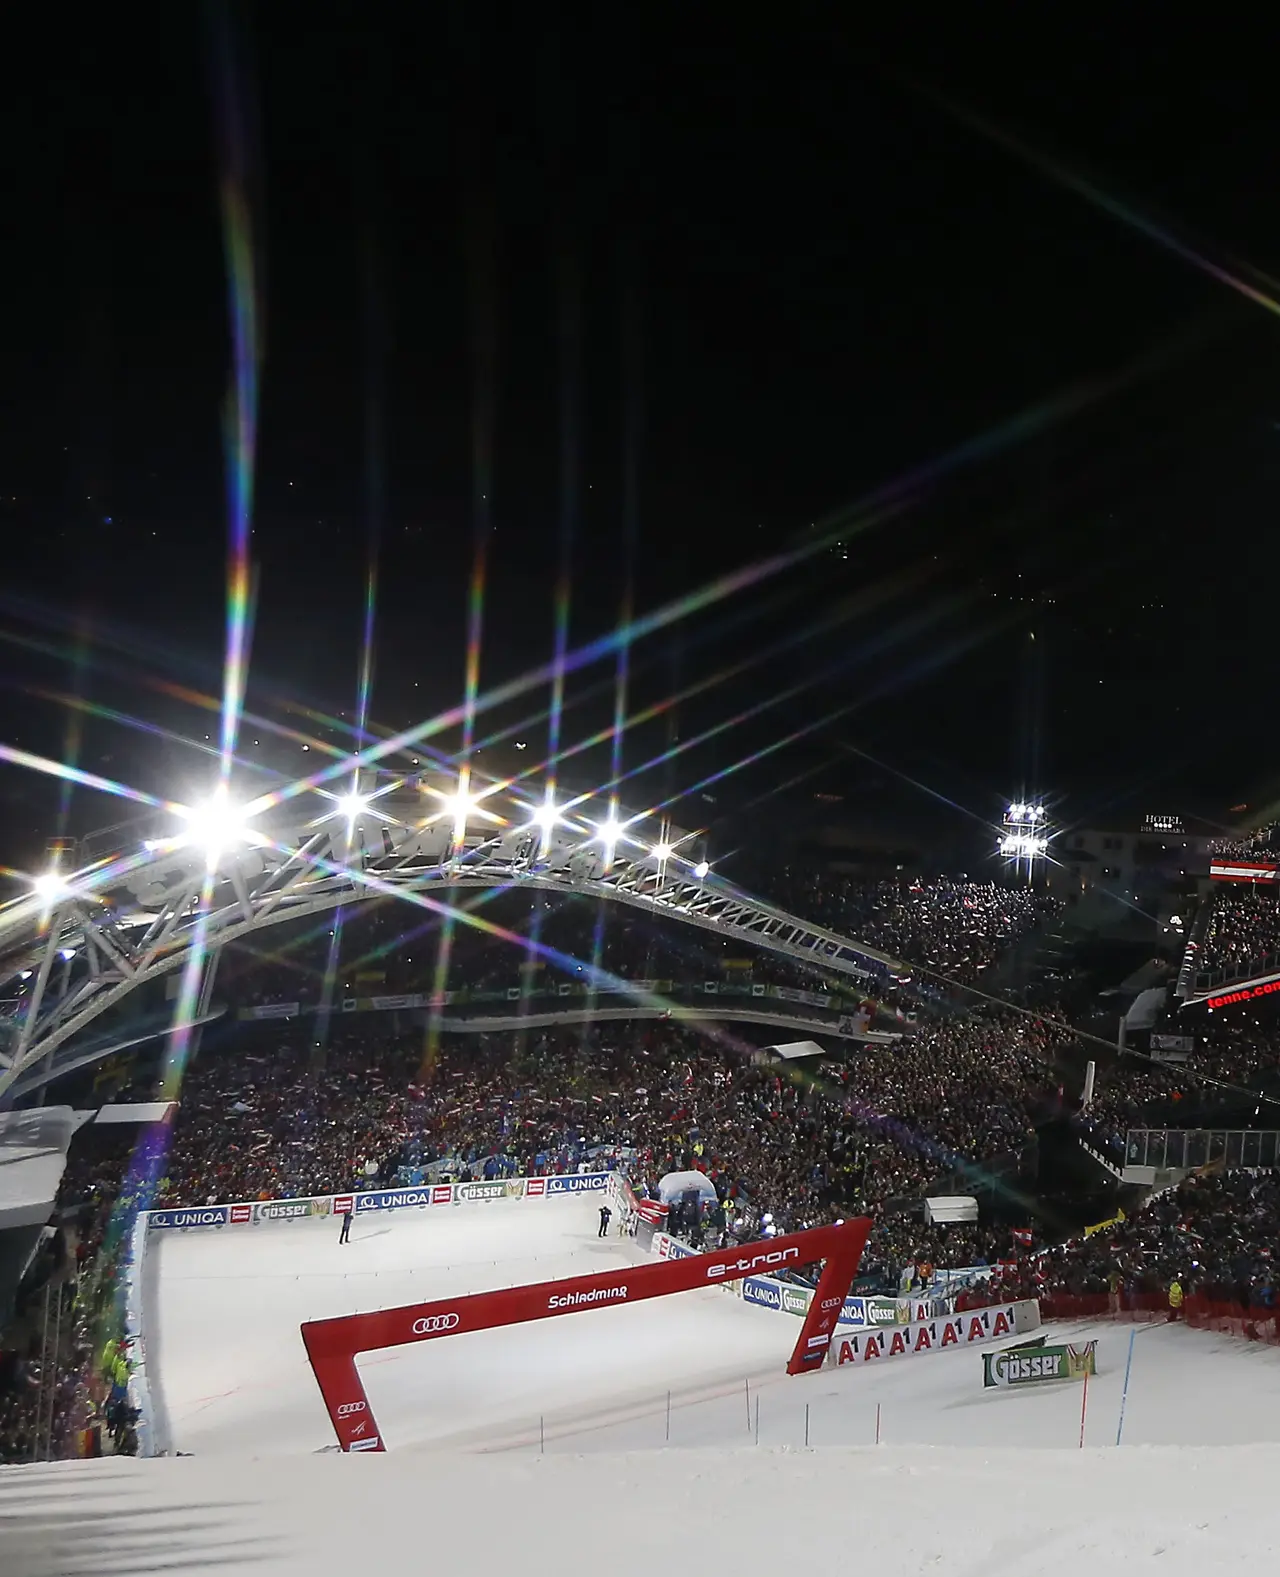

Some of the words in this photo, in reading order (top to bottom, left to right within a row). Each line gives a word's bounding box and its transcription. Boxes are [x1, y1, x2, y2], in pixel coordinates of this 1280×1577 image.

[1145, 814, 1182, 825] HOTEL
[569, 1177, 609, 1190] UNIQA
[381, 1193, 428, 1207] UNIQA
[457, 1184, 503, 1202] Gösser
[174, 1212, 224, 1225] UNIQA
[256, 1204, 308, 1222] Gösser
[707, 1247, 799, 1278] e-tron
[548, 1286, 627, 1308] Schladming
[755, 1287, 780, 1304] UNIQA
[840, 1305, 864, 1320] NIQA
[868, 1301, 895, 1323] Gösser
[838, 1336, 858, 1365] A1
[864, 1332, 885, 1361] A1
[889, 1327, 910, 1356] A1
[915, 1323, 936, 1351] A1
[941, 1317, 963, 1347] A1
[968, 1312, 989, 1341] A1
[993, 1307, 1015, 1336] A1
[990, 1352, 1061, 1385] Gösser
